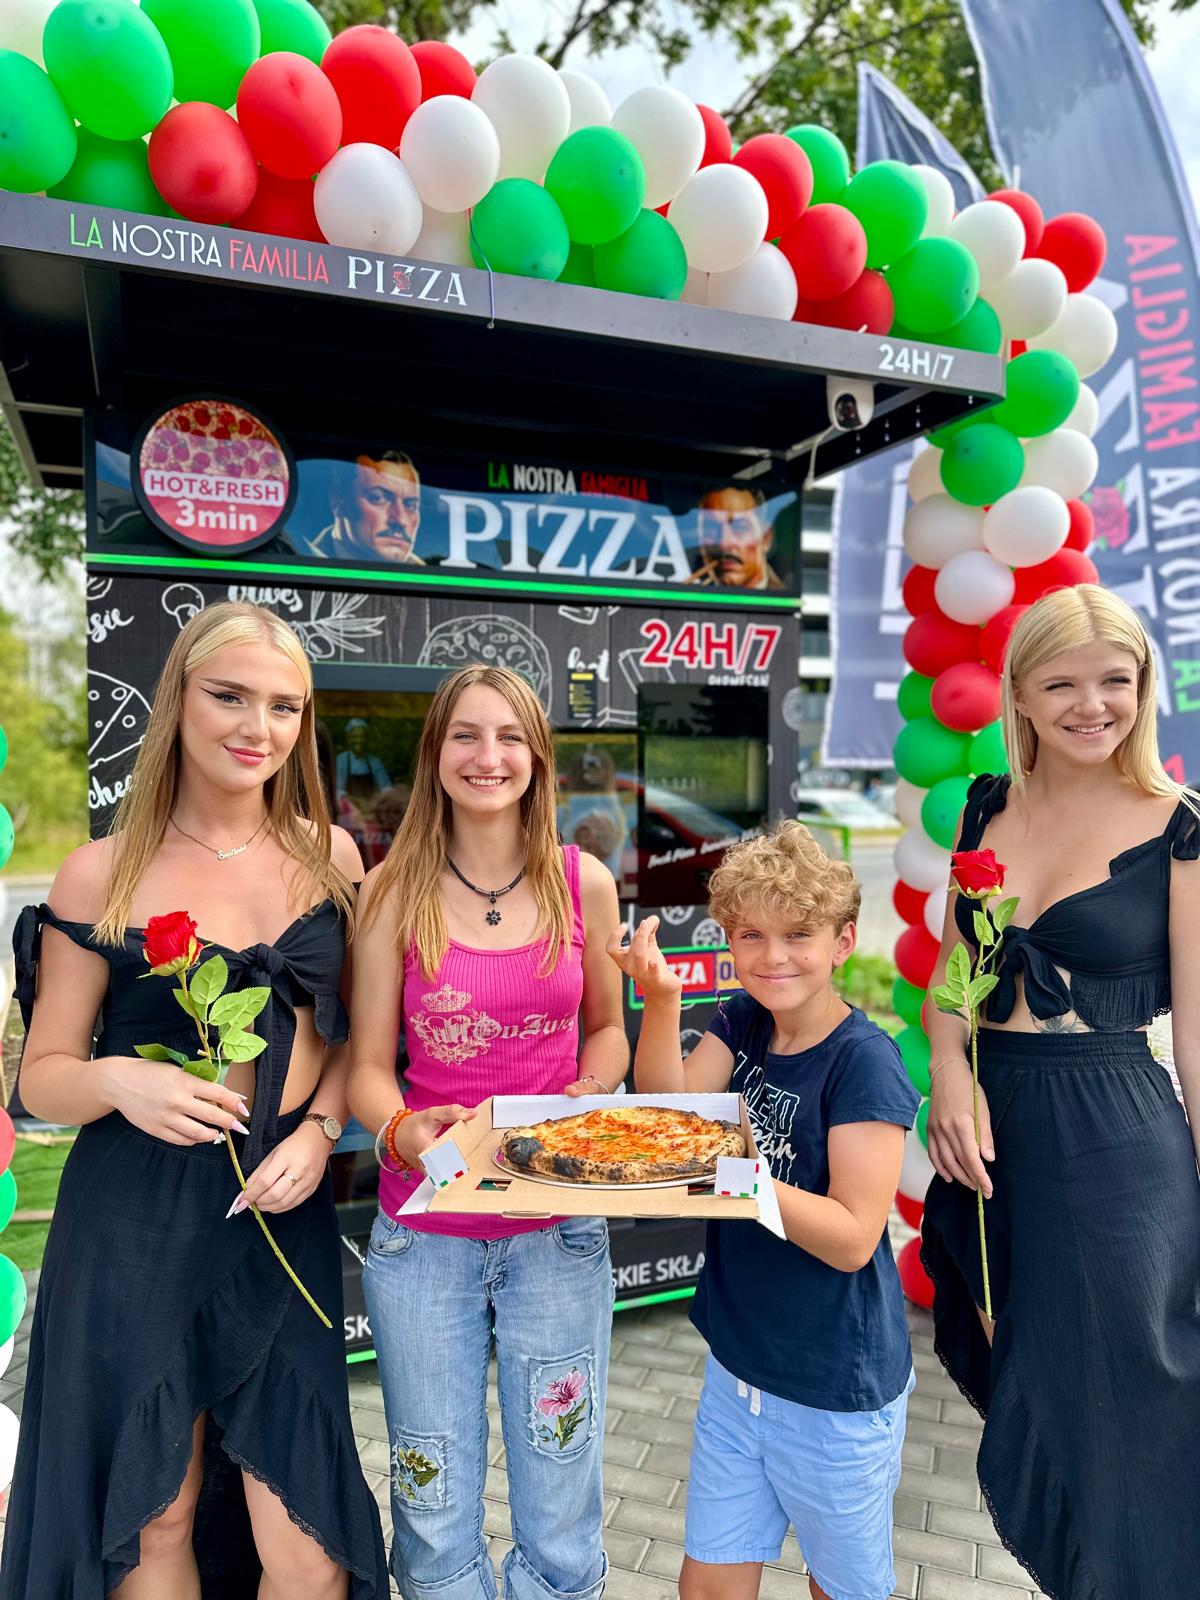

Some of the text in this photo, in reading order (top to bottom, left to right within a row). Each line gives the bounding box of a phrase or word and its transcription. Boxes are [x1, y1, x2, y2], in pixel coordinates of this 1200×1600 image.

[70, 213, 467, 306] LA NOSTRA FAMILIA PIZZA
[878, 343, 954, 381] 24H/7
[150, 474, 279, 501] HOT&FRESH
[488, 462, 648, 500] LA NOSTRA FAMIGLIA
[438, 495, 701, 584] PIZZA
[640, 618, 782, 674] 24H/7
